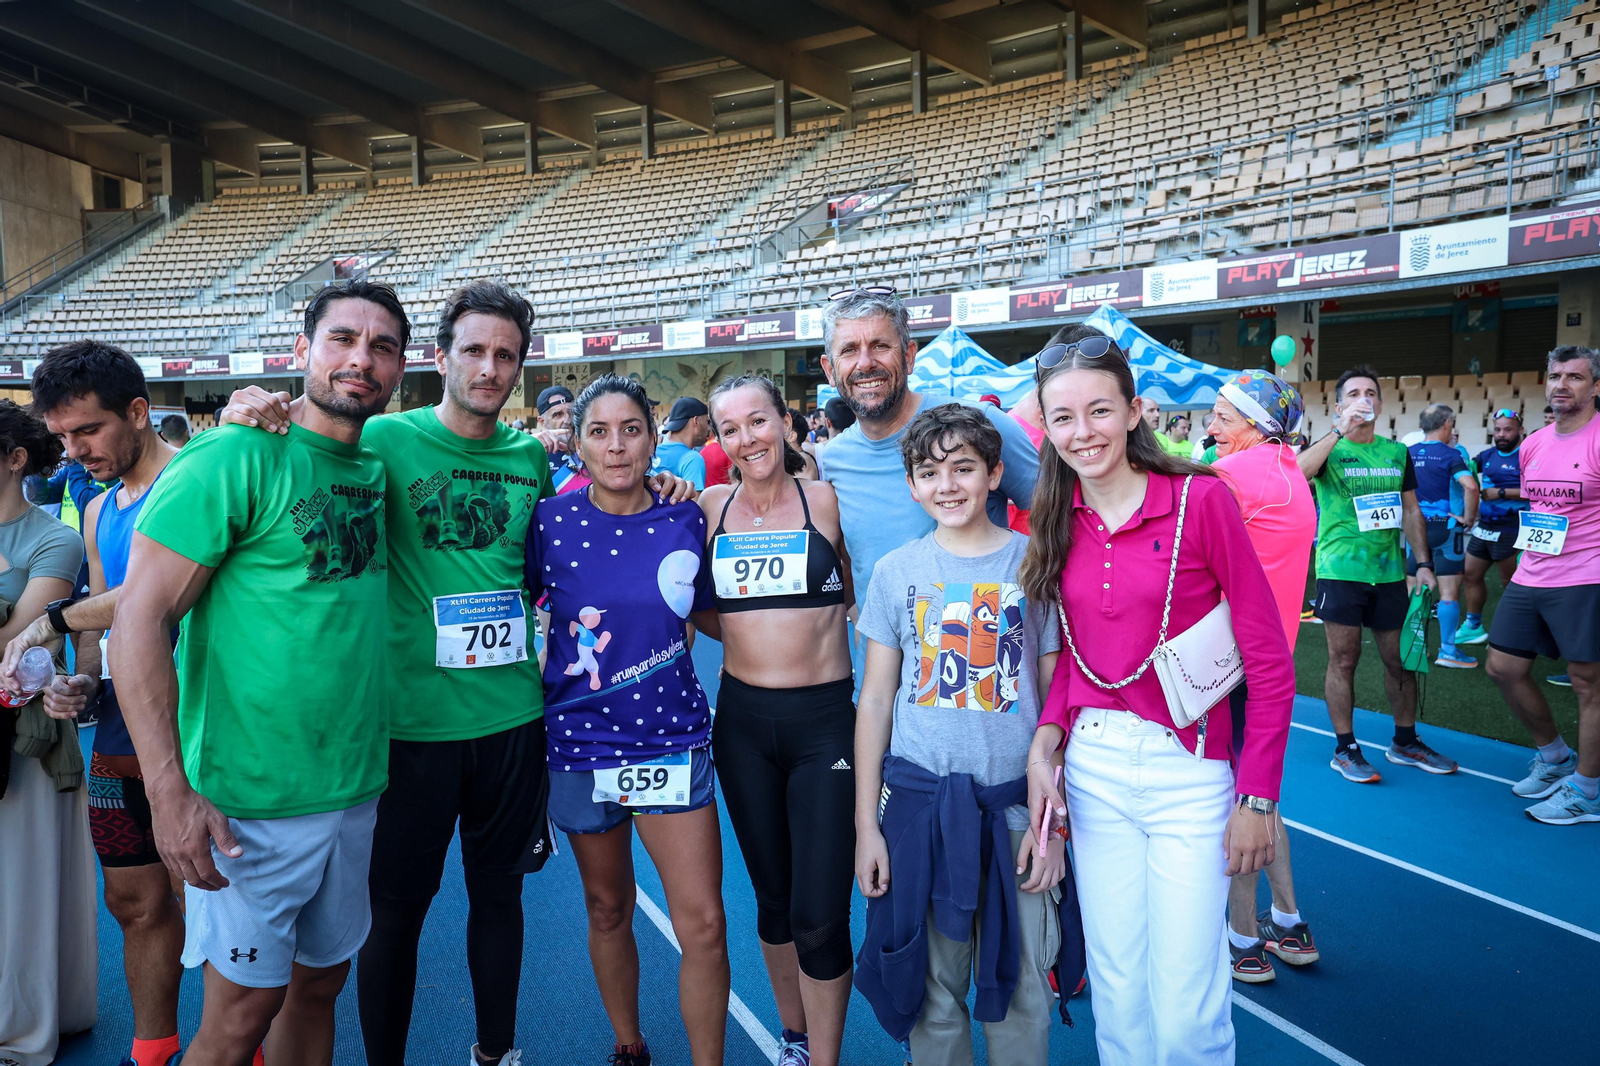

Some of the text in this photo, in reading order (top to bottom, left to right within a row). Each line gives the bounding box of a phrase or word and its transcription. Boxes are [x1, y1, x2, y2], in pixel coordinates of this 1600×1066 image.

[1435, 237, 1497, 251] Ayuntamiento
[1447, 249, 1469, 260] Jerez
[1167, 275, 1211, 285] Ayuntamiento
[1176, 283, 1192, 292] Jerez
[555, 364, 588, 374] JEREZ
[1344, 467, 1369, 477] MEDIO
[407, 477, 425, 493] 2023
[451, 469, 538, 489] CARRERA POPULAR
[1528, 487, 1576, 499] MALABAR
[289, 498, 307, 517] 2023
[1371, 508, 1396, 521] 461
[770, 533, 798, 541] Popular
[1528, 528, 1553, 545] 282
[734, 556, 784, 583] 970
[821, 583, 843, 592] adidas
[450, 598, 468, 606] XLIII
[497, 594, 515, 602] Popular
[459, 607, 486, 615] Ciudad
[487, 605, 496, 613] de
[906, 585, 920, 649] TUNED
[462, 621, 511, 652] 702
[908, 656, 921, 705] STAY
[617, 767, 669, 792] 659
